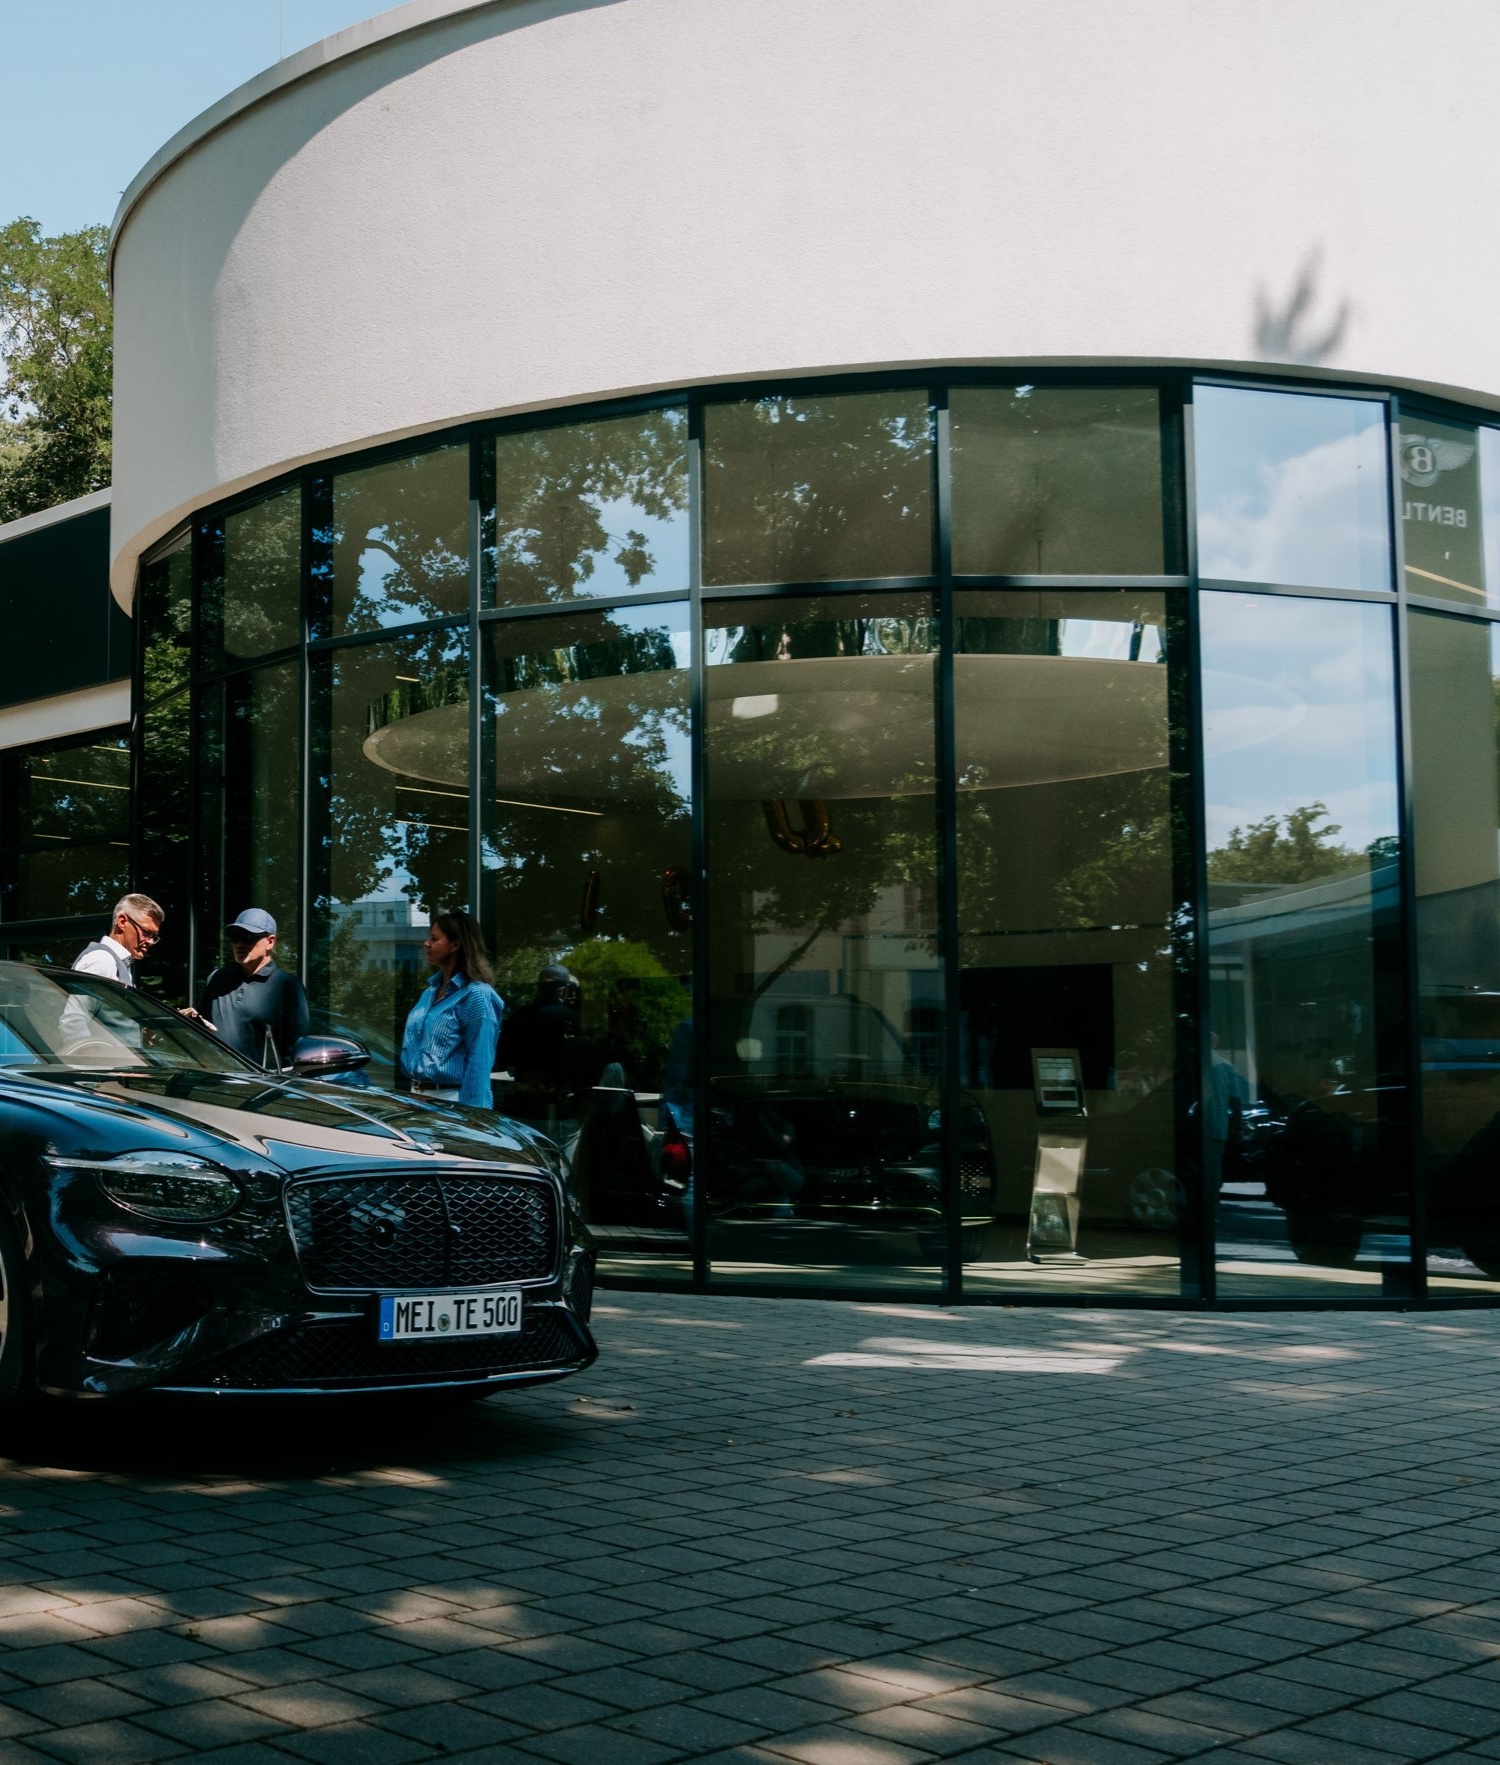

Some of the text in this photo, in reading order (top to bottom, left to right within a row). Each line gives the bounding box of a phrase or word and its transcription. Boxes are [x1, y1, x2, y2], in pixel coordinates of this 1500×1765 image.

[862, 1166, 871, 1176] S
[395, 1296, 518, 1333] MEI TE 500
[383, 1323, 389, 1332] D
